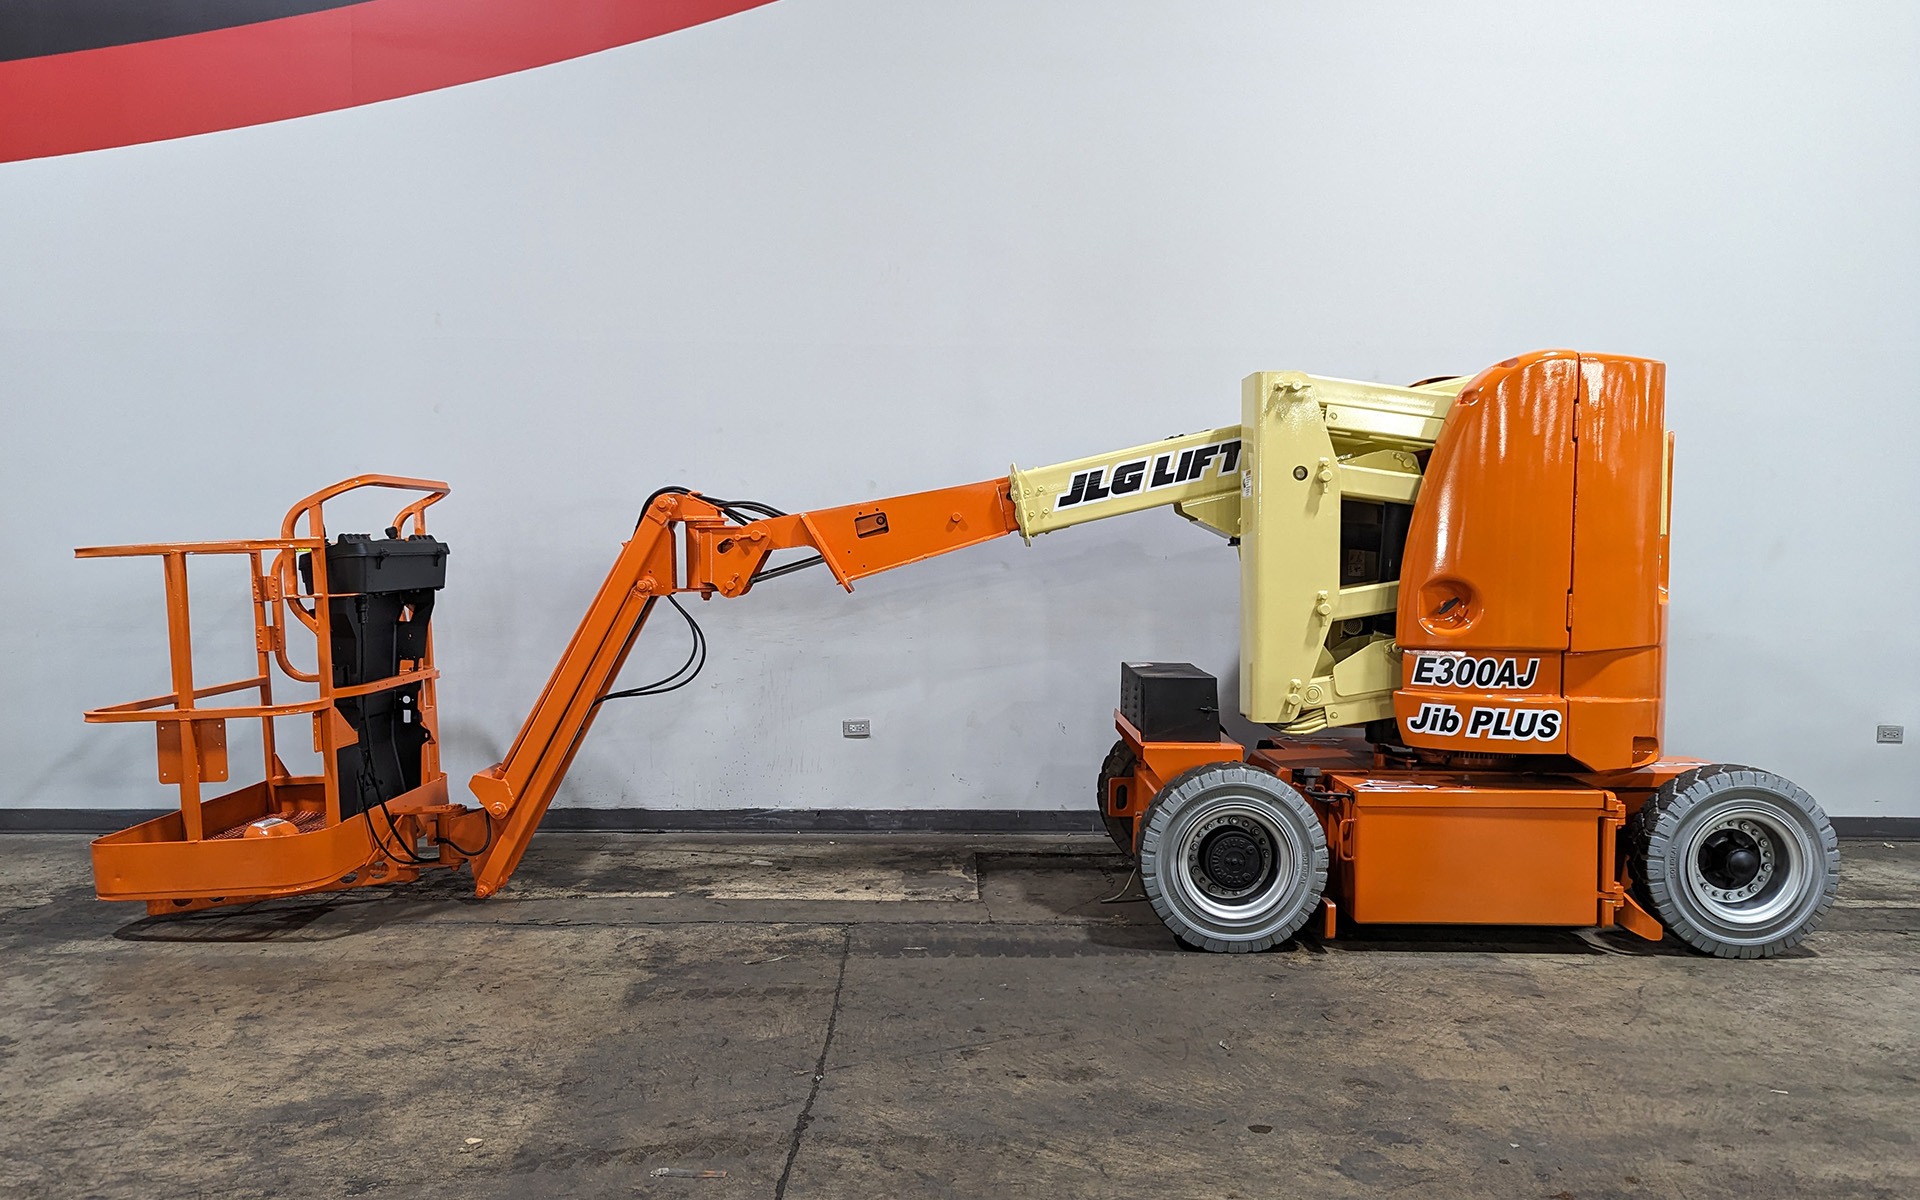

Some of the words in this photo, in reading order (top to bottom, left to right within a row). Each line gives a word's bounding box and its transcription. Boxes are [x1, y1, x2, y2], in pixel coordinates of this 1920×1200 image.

[1057, 460, 1148, 508] JLG
[1150, 440, 1241, 488] LIFT
[1413, 657, 1539, 688] E300AJ
[1410, 706, 1460, 733] Jib
[1469, 710, 1559, 739] PLUS
